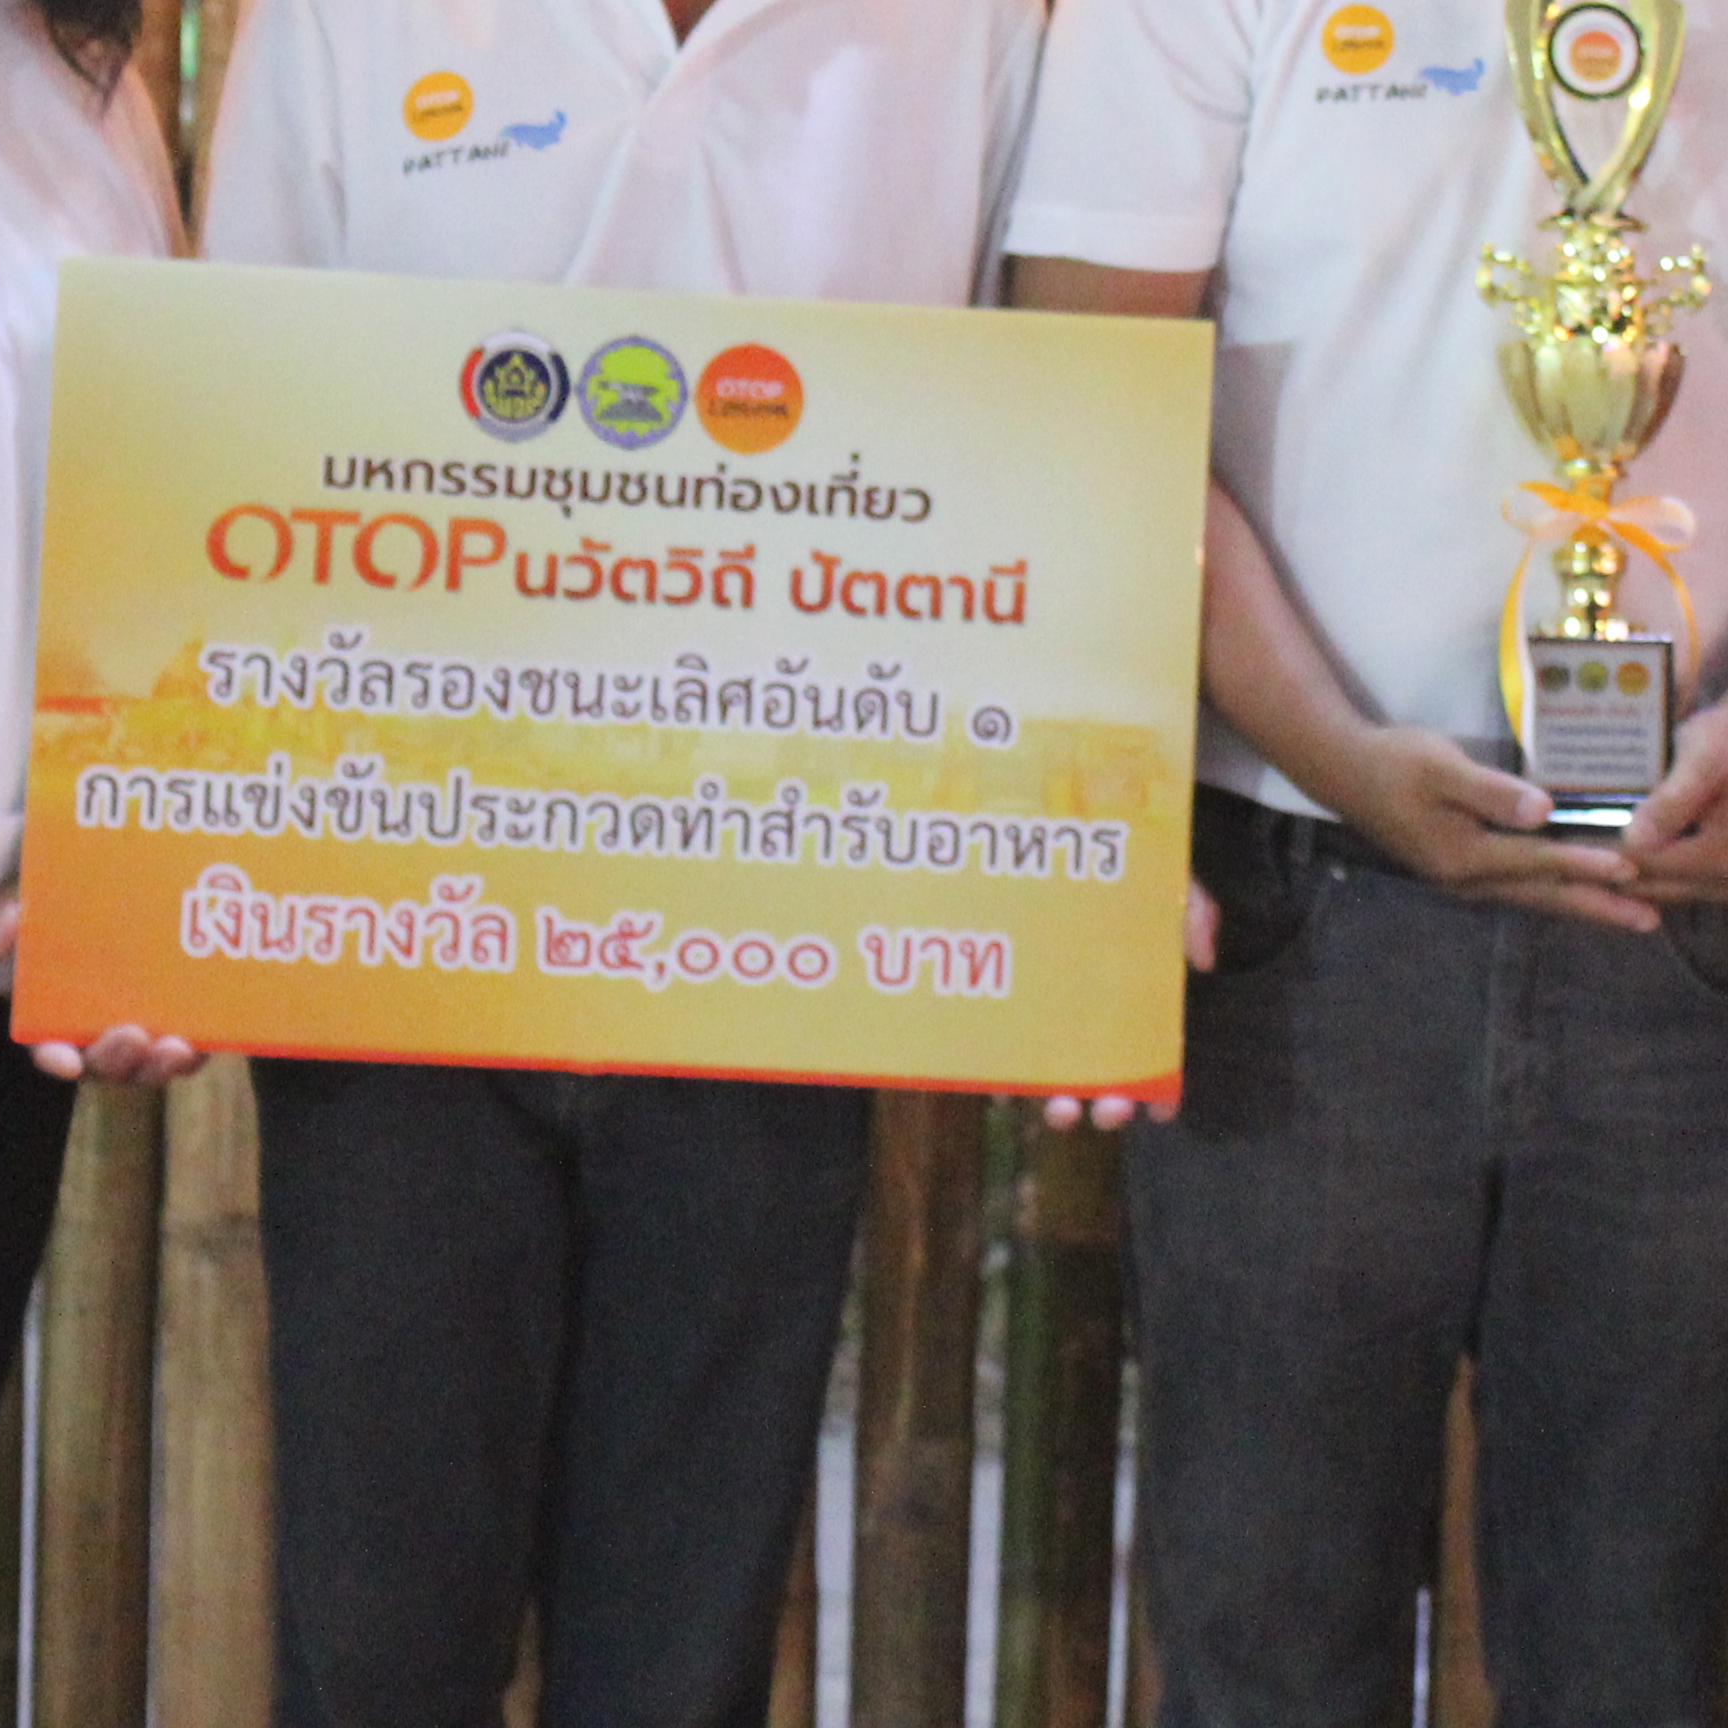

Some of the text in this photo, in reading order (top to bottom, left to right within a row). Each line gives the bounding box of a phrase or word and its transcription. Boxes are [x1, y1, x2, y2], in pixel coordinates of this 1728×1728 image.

[322, 453, 932, 523] มหกรรมชุมชนท่องเที่ยว
[205, 503, 1028, 625] OTOP นวัตวิถี ปัตตานี
[205, 631, 1013, 743] รางวัลรองชนะเลิศอันดับ ๑
[83, 762, 1122, 876] การแข่งขันประกวดทำสำรับอาหาร
[187, 873, 1004, 990] เงินรางวัล ๒๕,๐๐๐ บาท
